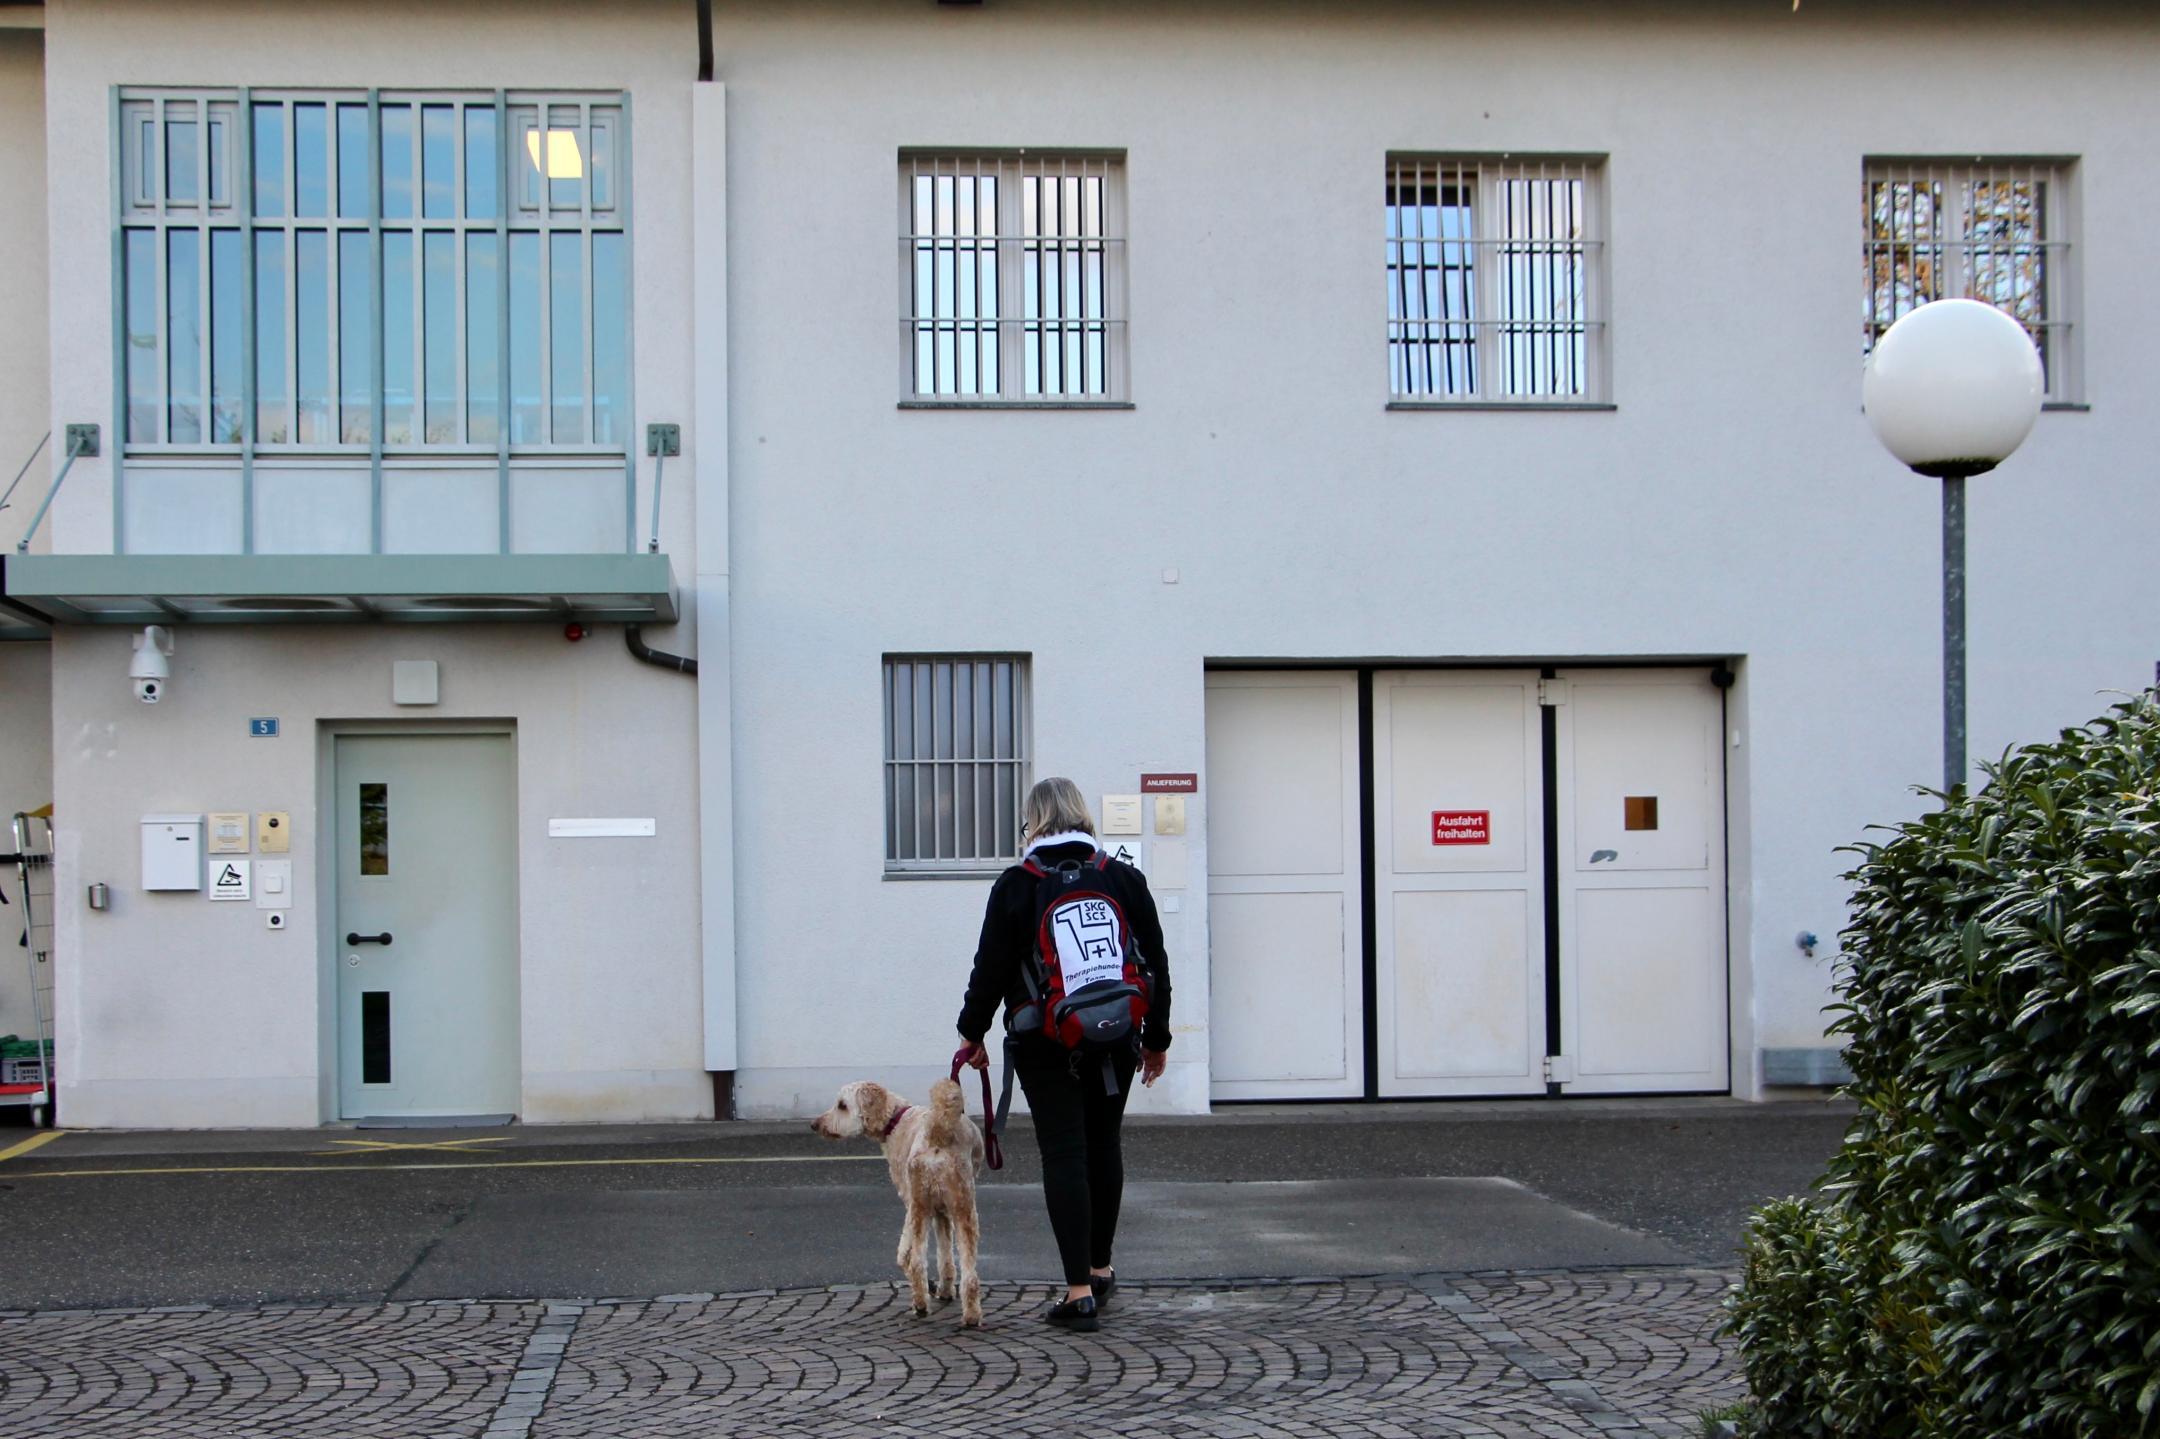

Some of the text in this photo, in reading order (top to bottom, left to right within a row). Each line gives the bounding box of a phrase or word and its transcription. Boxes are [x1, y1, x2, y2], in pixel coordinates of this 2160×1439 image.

[260, 721, 268, 734] 5
[1439, 815, 1483, 826] Ausfahrt
[1436, 828, 1486, 839] freihalten
[1084, 902, 1105, 911] SKG
[1086, 912, 1106, 921] SCS
